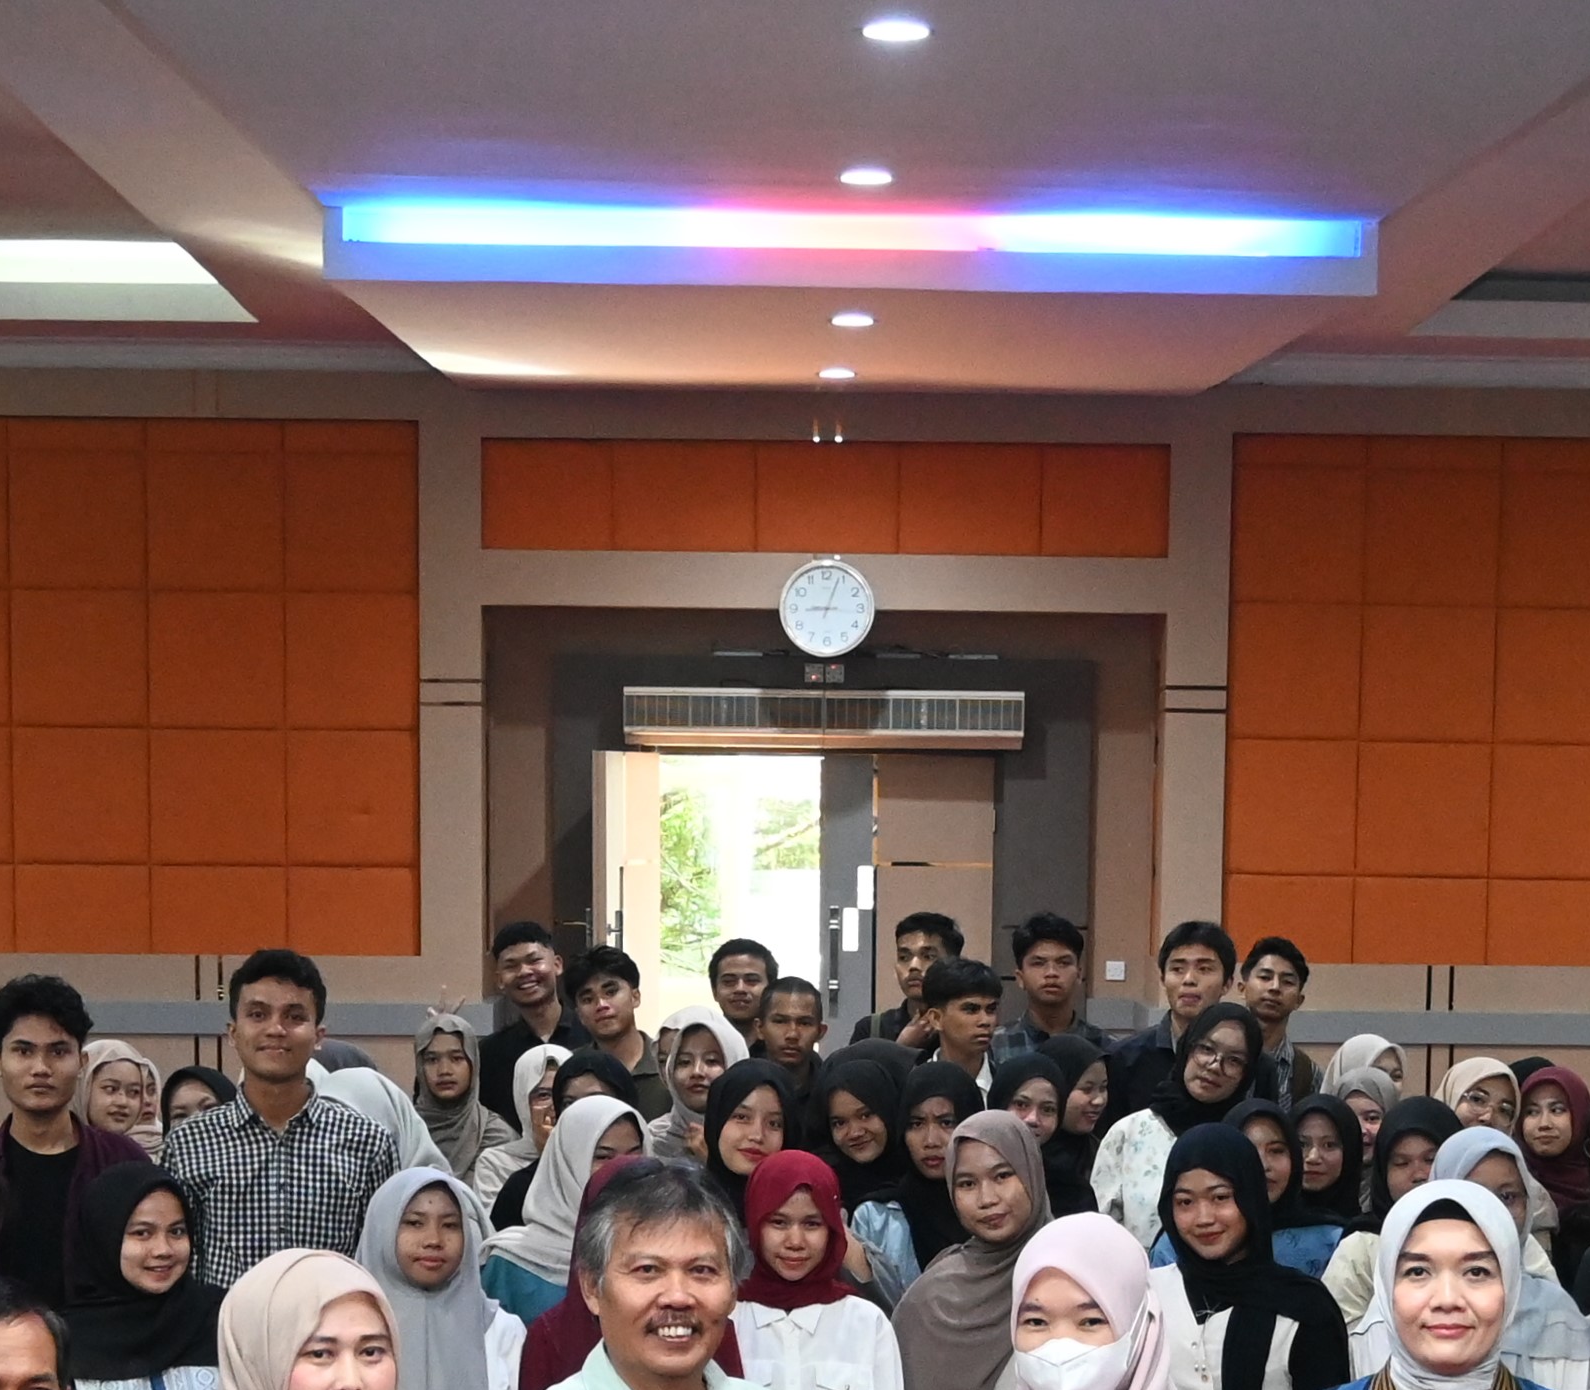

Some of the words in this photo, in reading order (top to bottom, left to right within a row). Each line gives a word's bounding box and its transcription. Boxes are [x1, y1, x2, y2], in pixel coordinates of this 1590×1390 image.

[807, 575, 814, 584] 11
[821, 570, 832, 580] 12
[795, 587, 807, 597] 10
[851, 587, 859, 597] 2
[789, 603, 798, 613] 9
[856, 603, 865, 613] 3
[795, 620, 803, 630] 8
[851, 620, 859, 630] 4
[808, 631, 815, 642] 7
[822, 636, 832, 647] 6
[840, 632, 849, 642] 5
